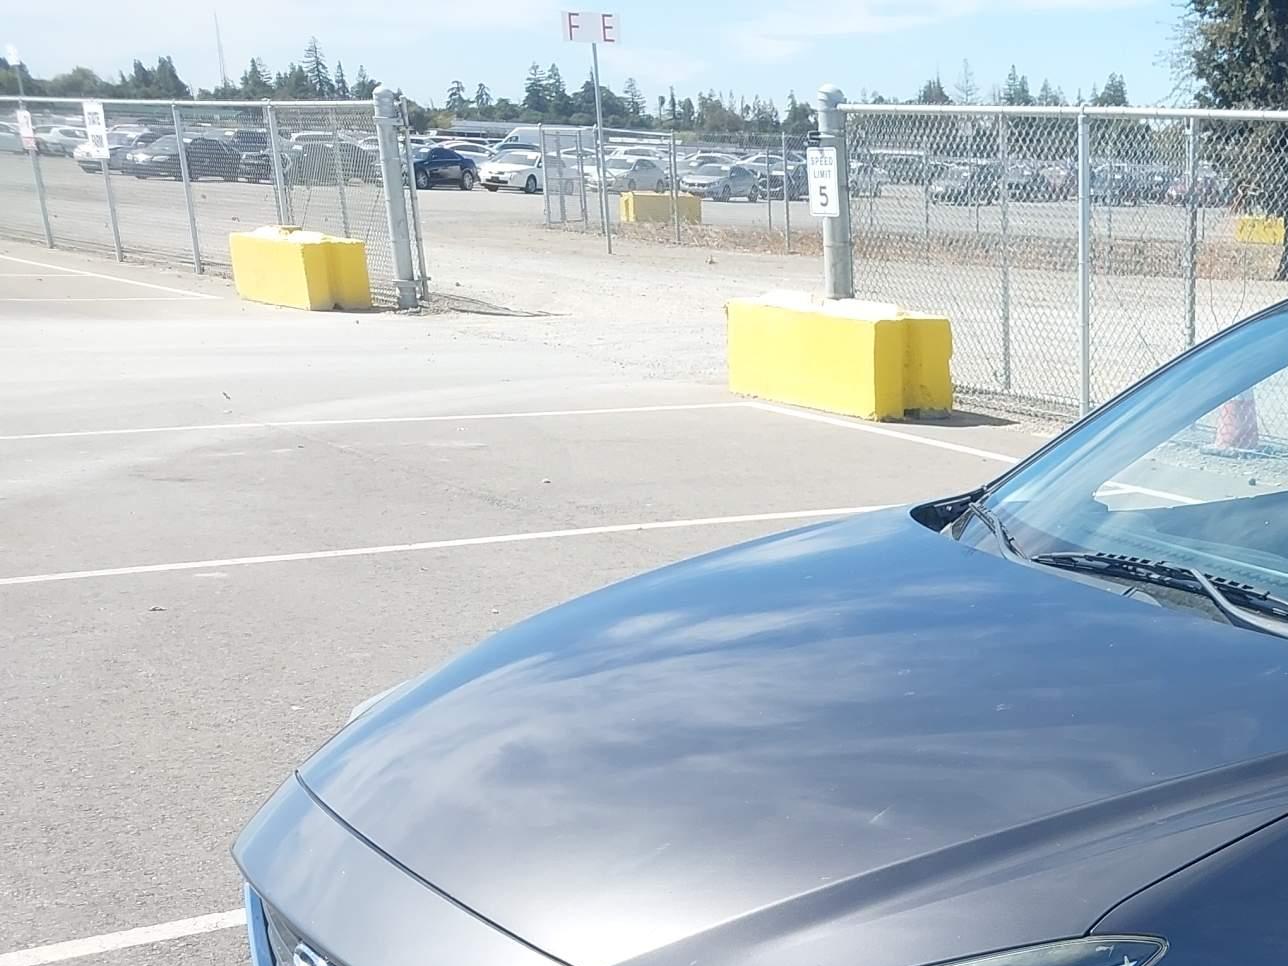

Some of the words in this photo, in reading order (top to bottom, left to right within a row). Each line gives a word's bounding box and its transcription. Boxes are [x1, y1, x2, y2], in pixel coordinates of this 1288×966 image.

[568, 12, 580, 41] F
[602, 14, 615, 42] E
[810, 156, 833, 166] SPEED
[813, 169, 831, 179] LIMIT
[819, 185, 829, 207] 5
